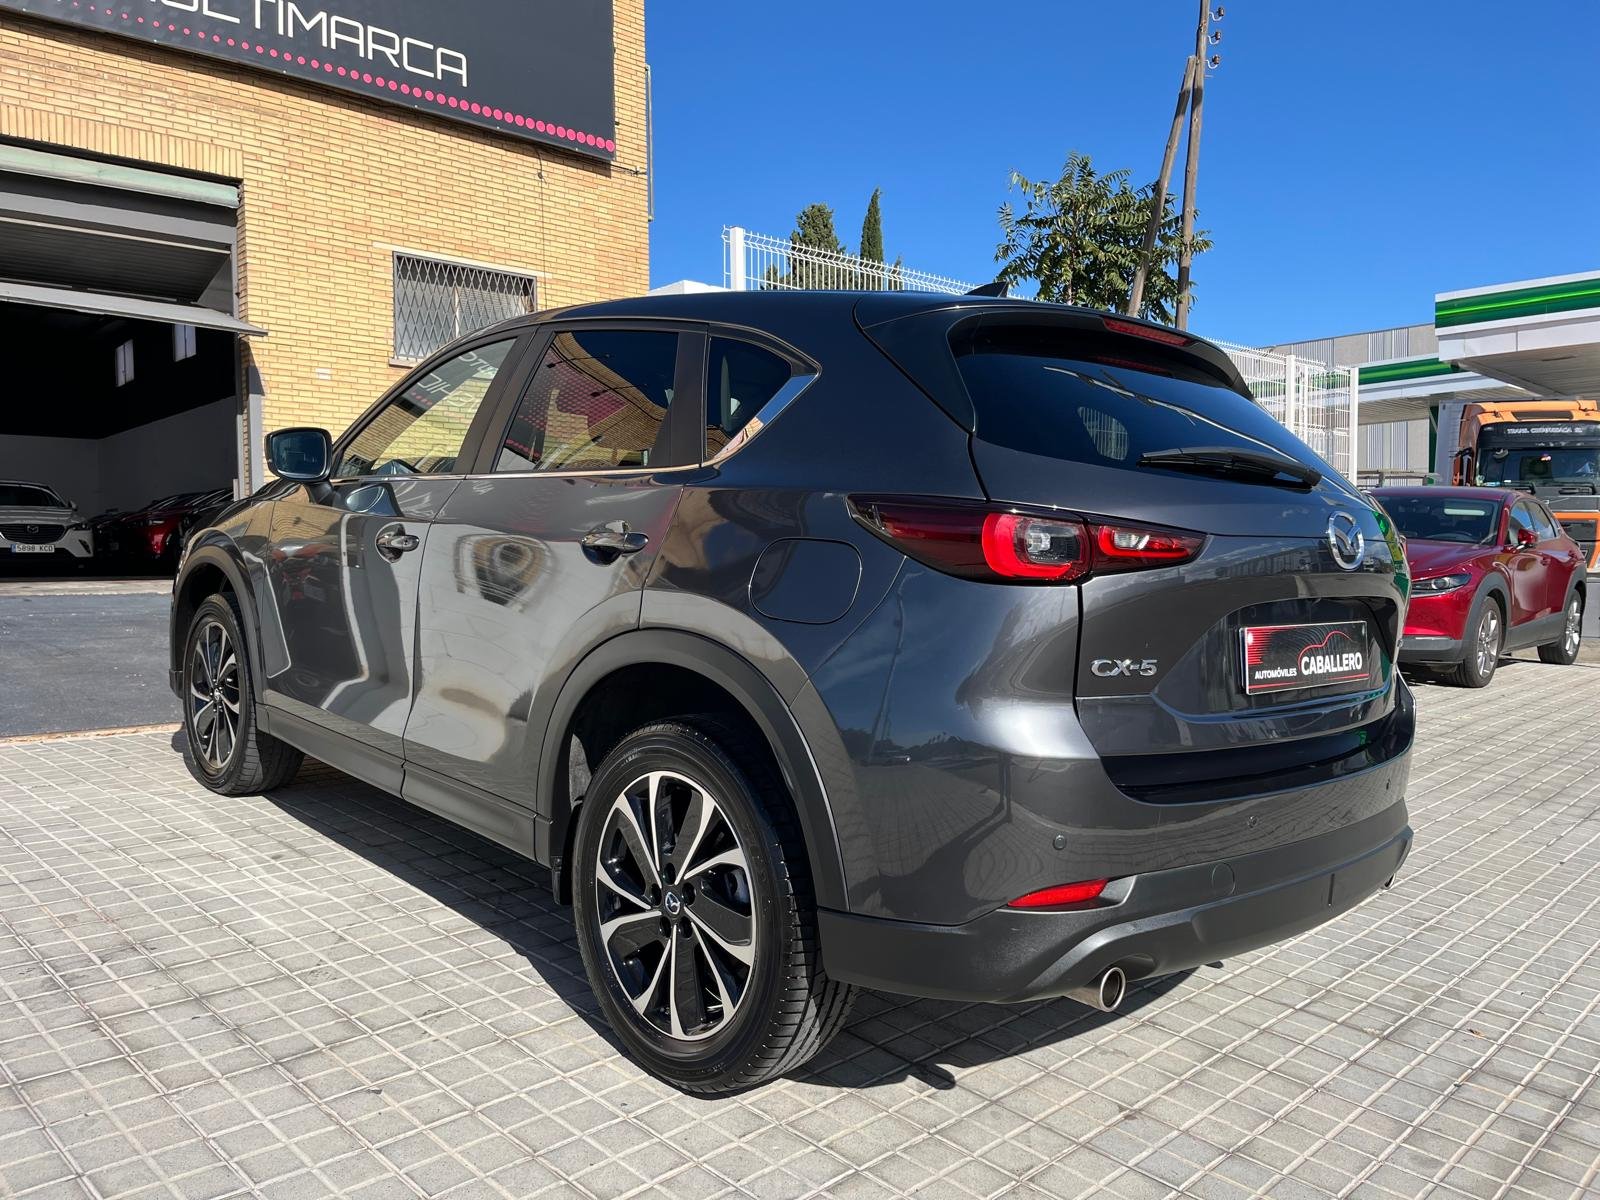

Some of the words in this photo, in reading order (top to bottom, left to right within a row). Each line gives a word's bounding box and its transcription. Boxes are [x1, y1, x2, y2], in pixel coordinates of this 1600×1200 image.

[1091, 659, 1158, 677] CX-5
[1254, 667, 1297, 680] AUTOMÓVILES
[1301, 652, 1363, 675] CABALLERO
